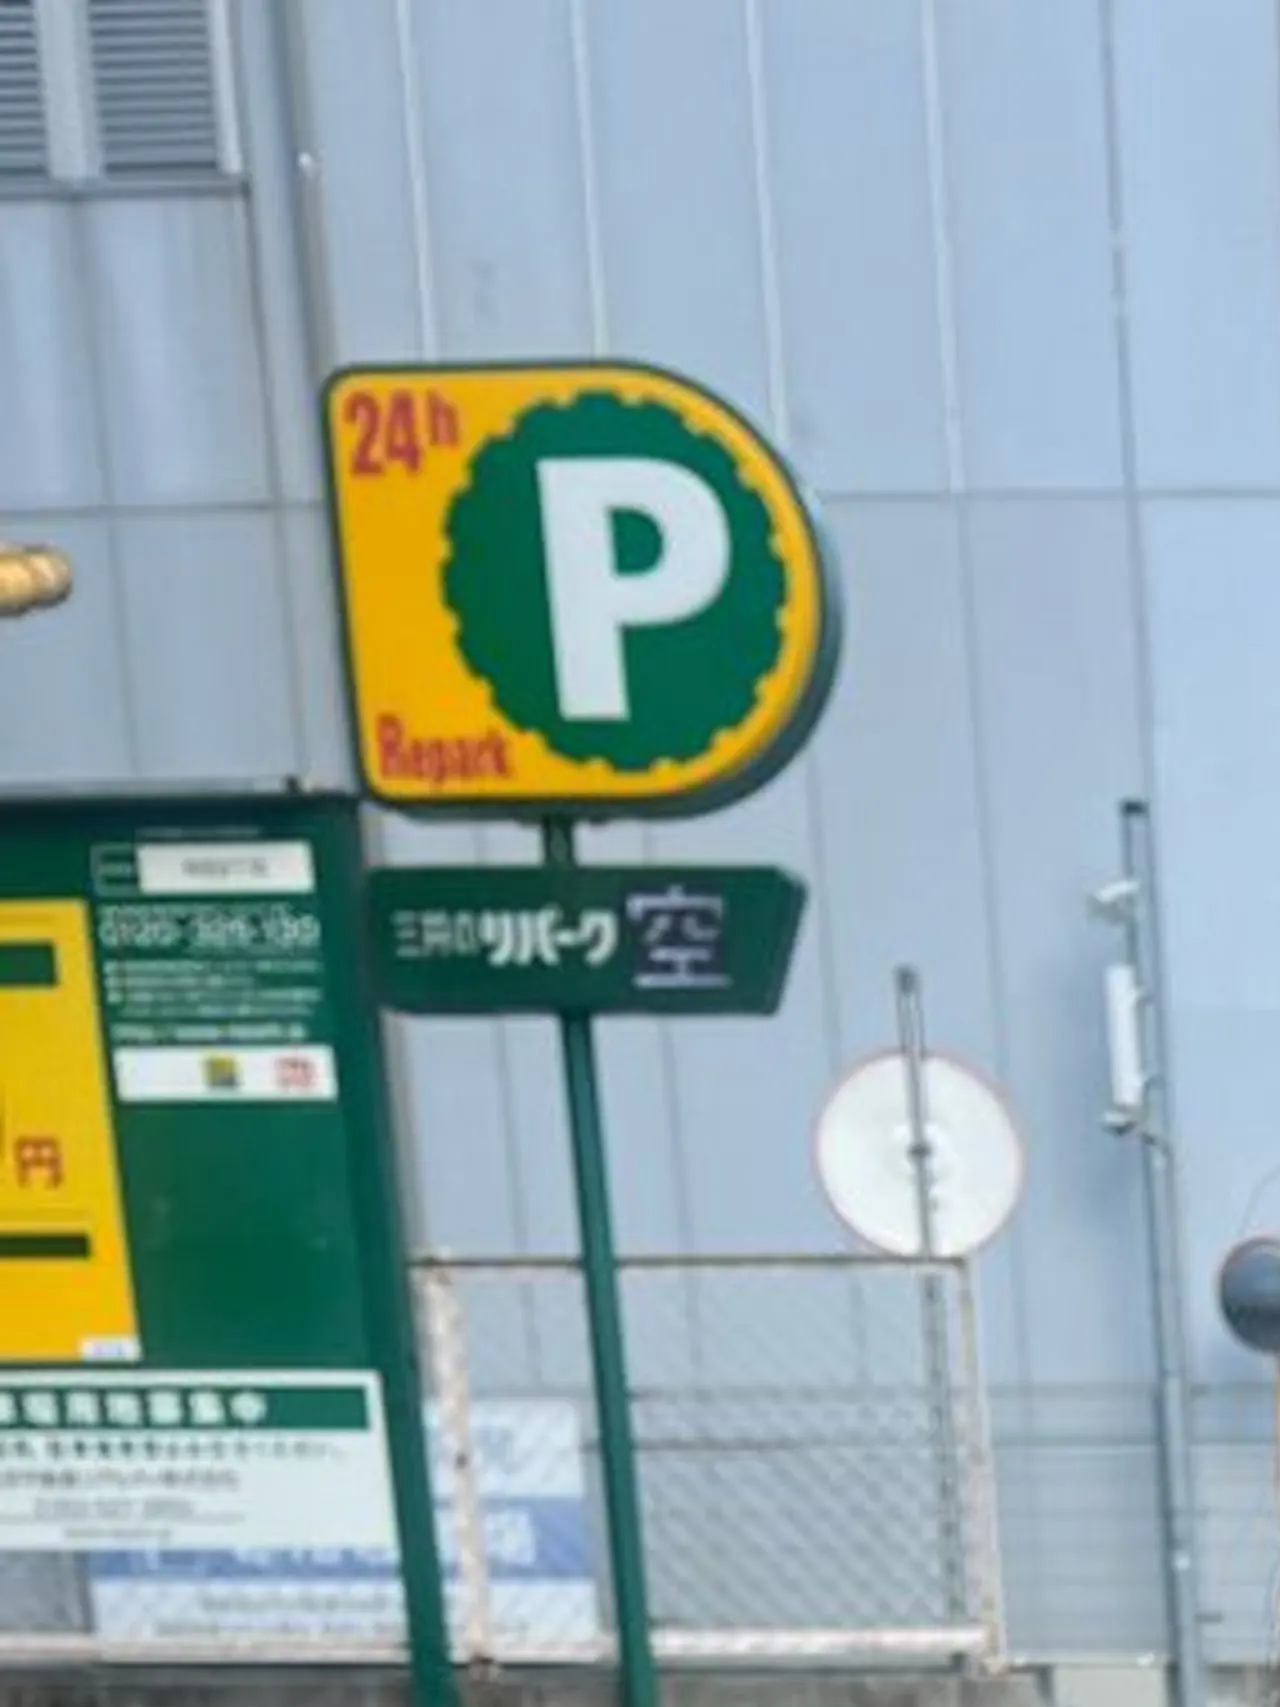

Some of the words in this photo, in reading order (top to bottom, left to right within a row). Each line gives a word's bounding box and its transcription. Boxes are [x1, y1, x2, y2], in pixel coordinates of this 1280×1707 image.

[346, 388, 460, 476] 24h
[537, 456, 732, 721] P
[376, 712, 512, 788] Repark
[625, 884, 733, 989] 空
[14, 1134, 63, 1192] 円
